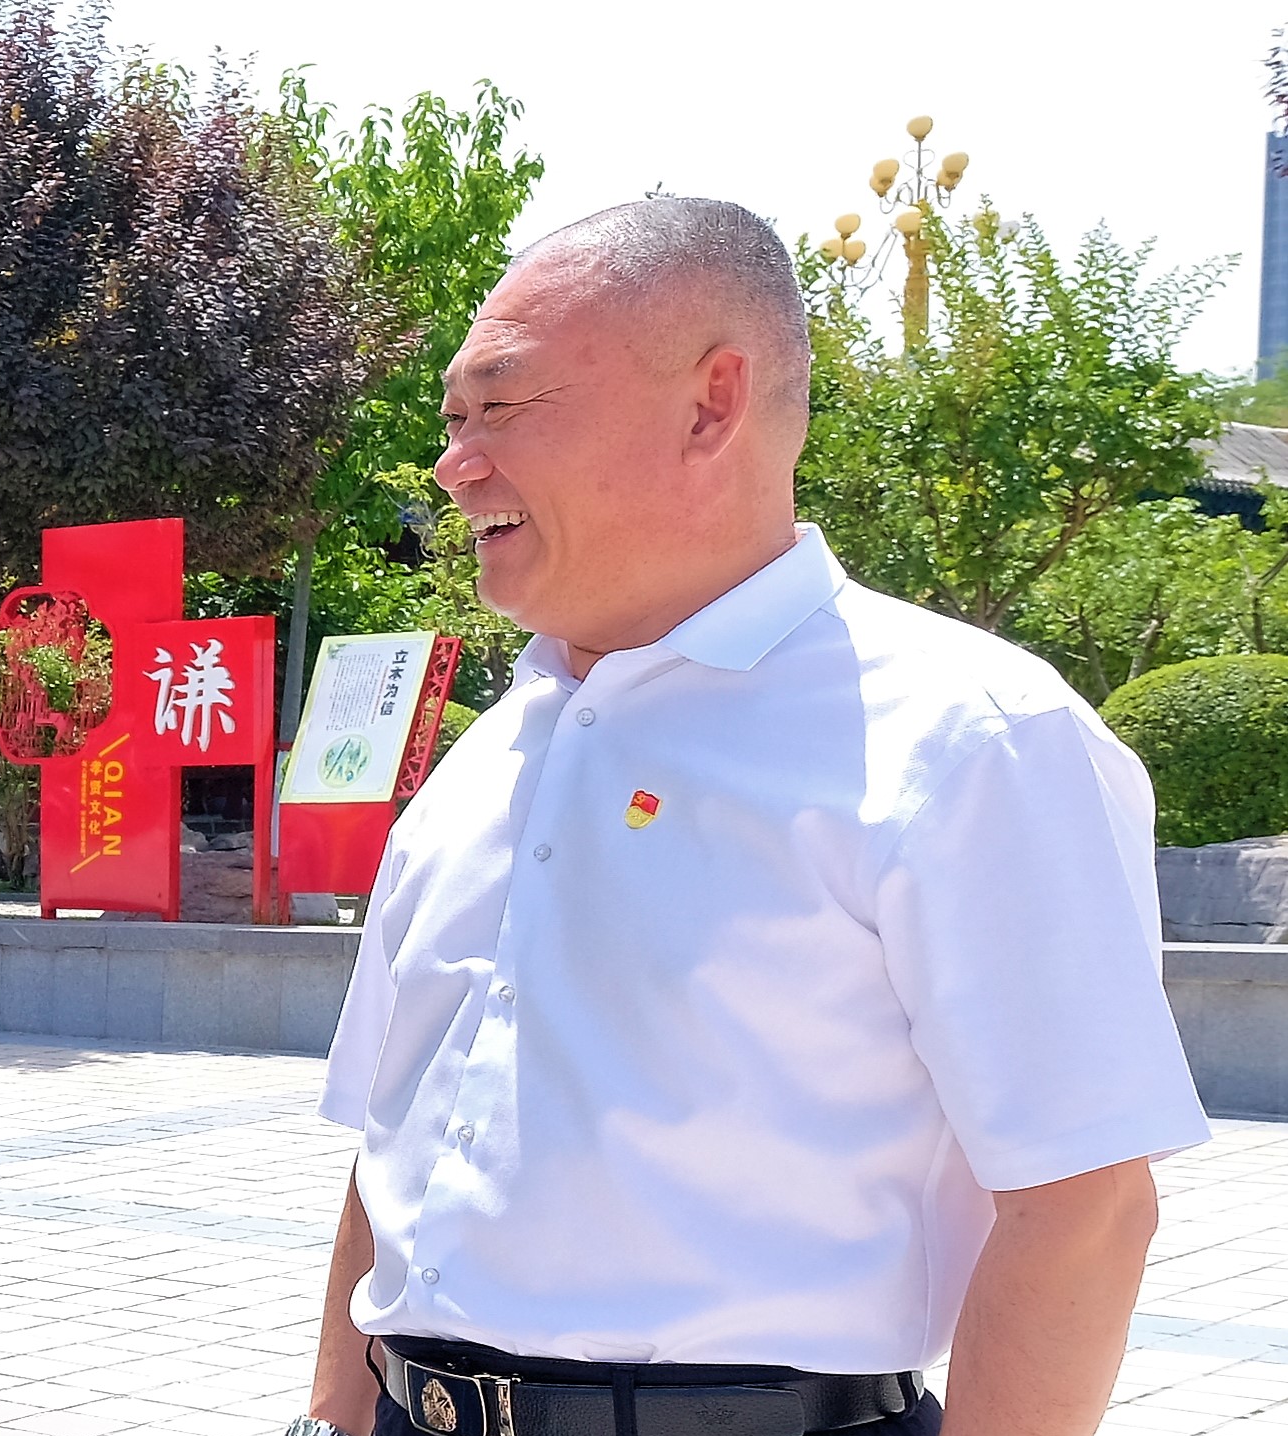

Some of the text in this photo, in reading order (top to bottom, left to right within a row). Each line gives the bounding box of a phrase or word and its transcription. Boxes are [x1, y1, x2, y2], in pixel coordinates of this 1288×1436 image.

[143, 638, 236, 752] 谦
[380, 649, 409, 716] 立木为信
[102, 761, 123, 855] QIAN
